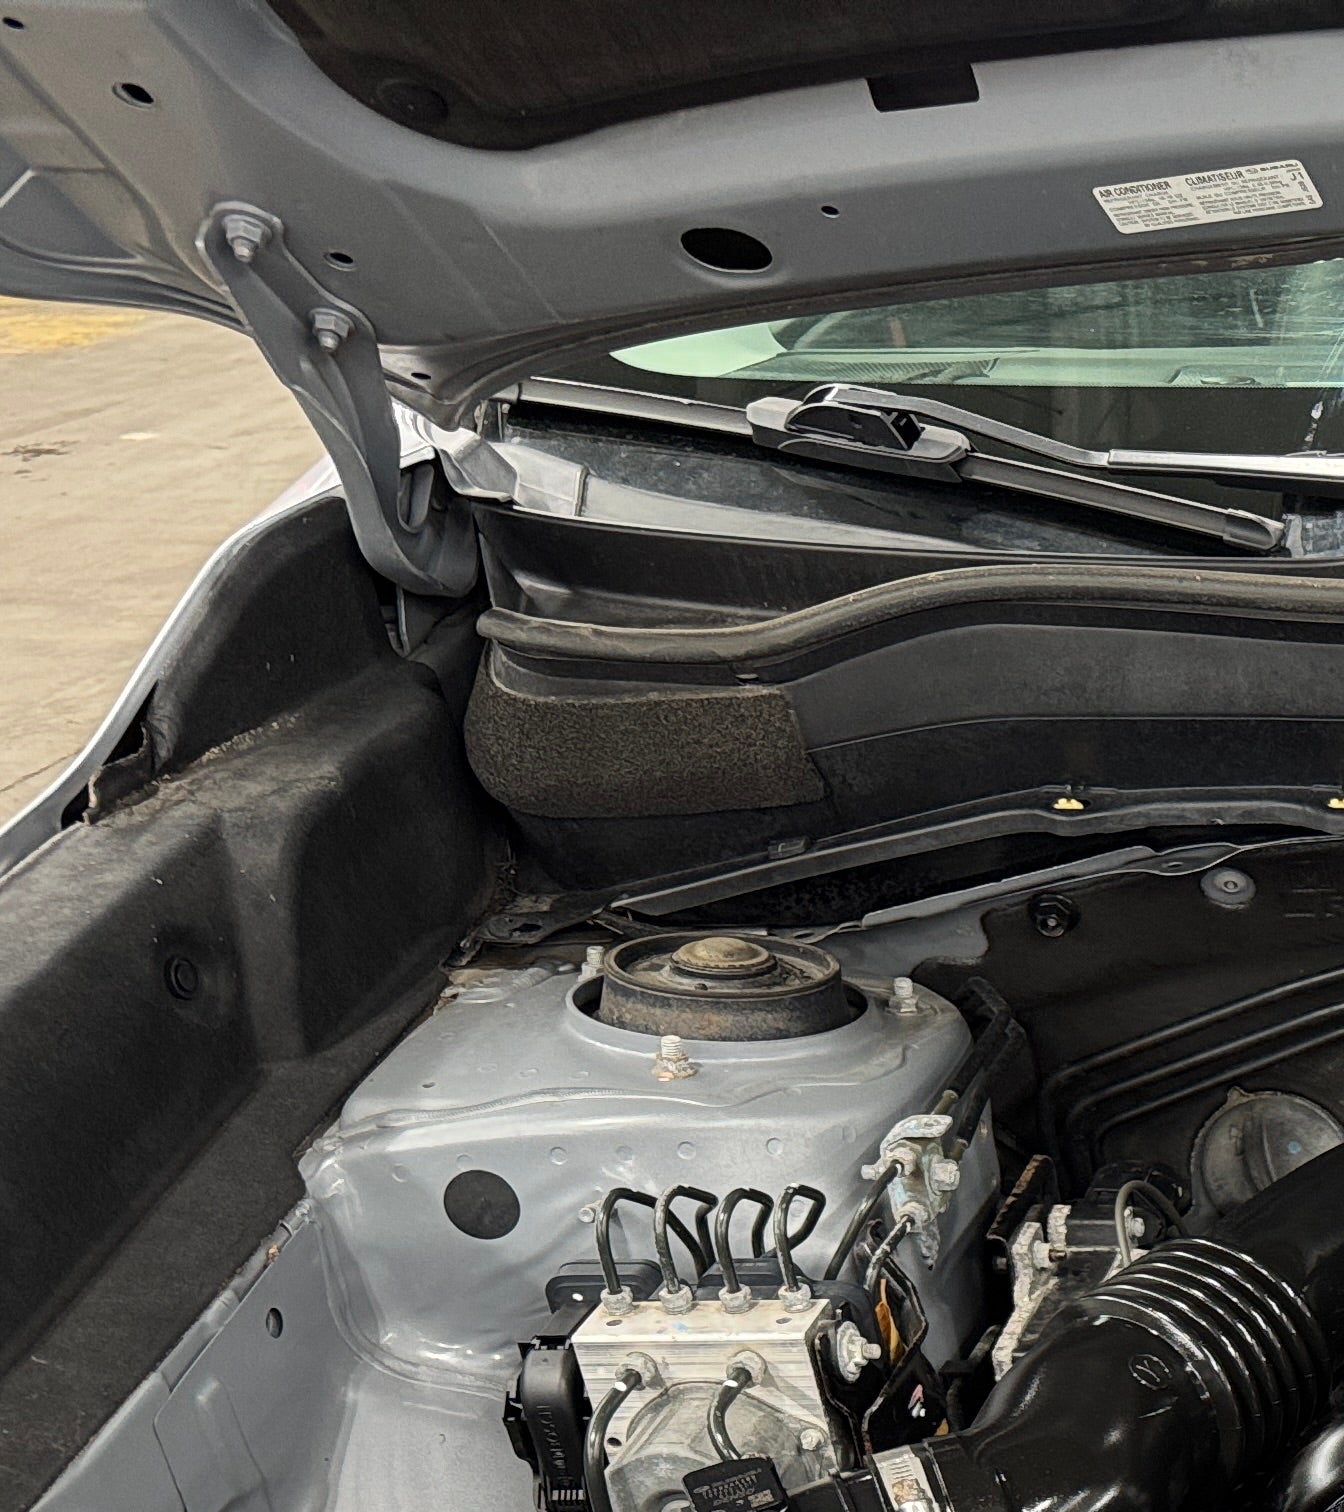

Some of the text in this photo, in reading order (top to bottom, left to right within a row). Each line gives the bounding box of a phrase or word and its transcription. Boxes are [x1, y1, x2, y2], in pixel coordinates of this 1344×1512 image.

[1184, 169, 1245, 187] CLIMATISEUR
[1098, 187, 1113, 199] AIR
[1113, 180, 1171, 197] CONDITIONER
